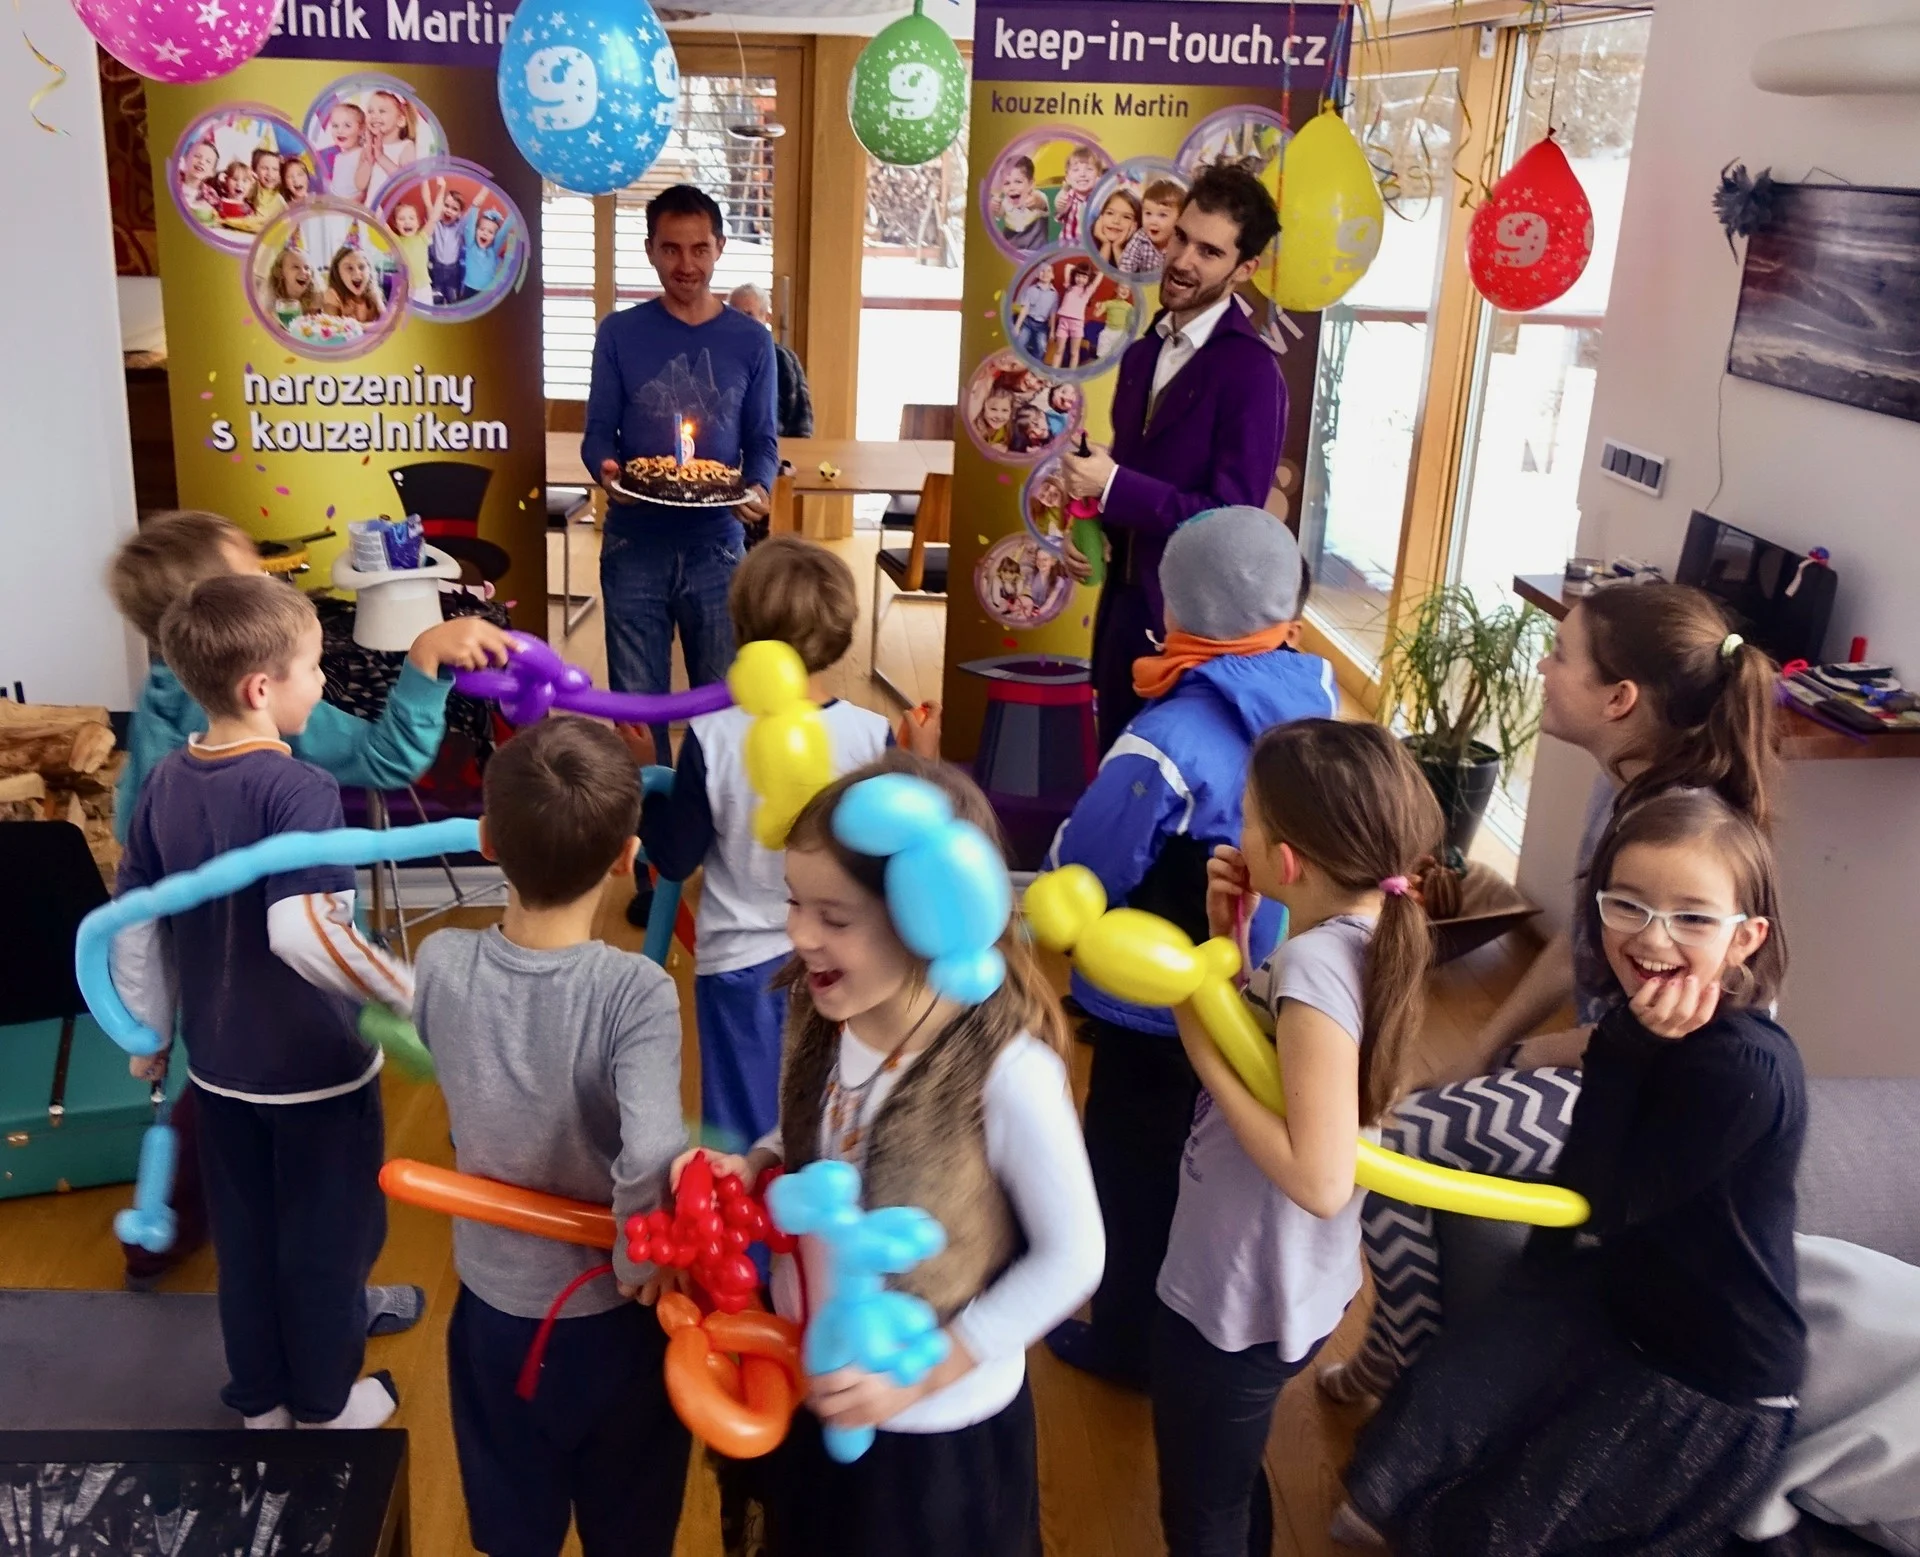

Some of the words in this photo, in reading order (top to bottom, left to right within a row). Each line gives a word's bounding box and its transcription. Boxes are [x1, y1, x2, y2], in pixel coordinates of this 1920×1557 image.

[994, 17, 1326, 70] keep-in-touch.cz
[525, 45, 598, 131] 9
[888, 62, 939, 120] 9
[991, 90, 1104, 116] kouzelník
[1114, 92, 1189, 117] Martin
[1335, 215, 1381, 273] 9
[1493, 211, 1549, 268] 9
[243, 363, 475, 415] narozeniny
[211, 419, 238, 451] s
[250, 410, 509, 451] kouzelníkem
